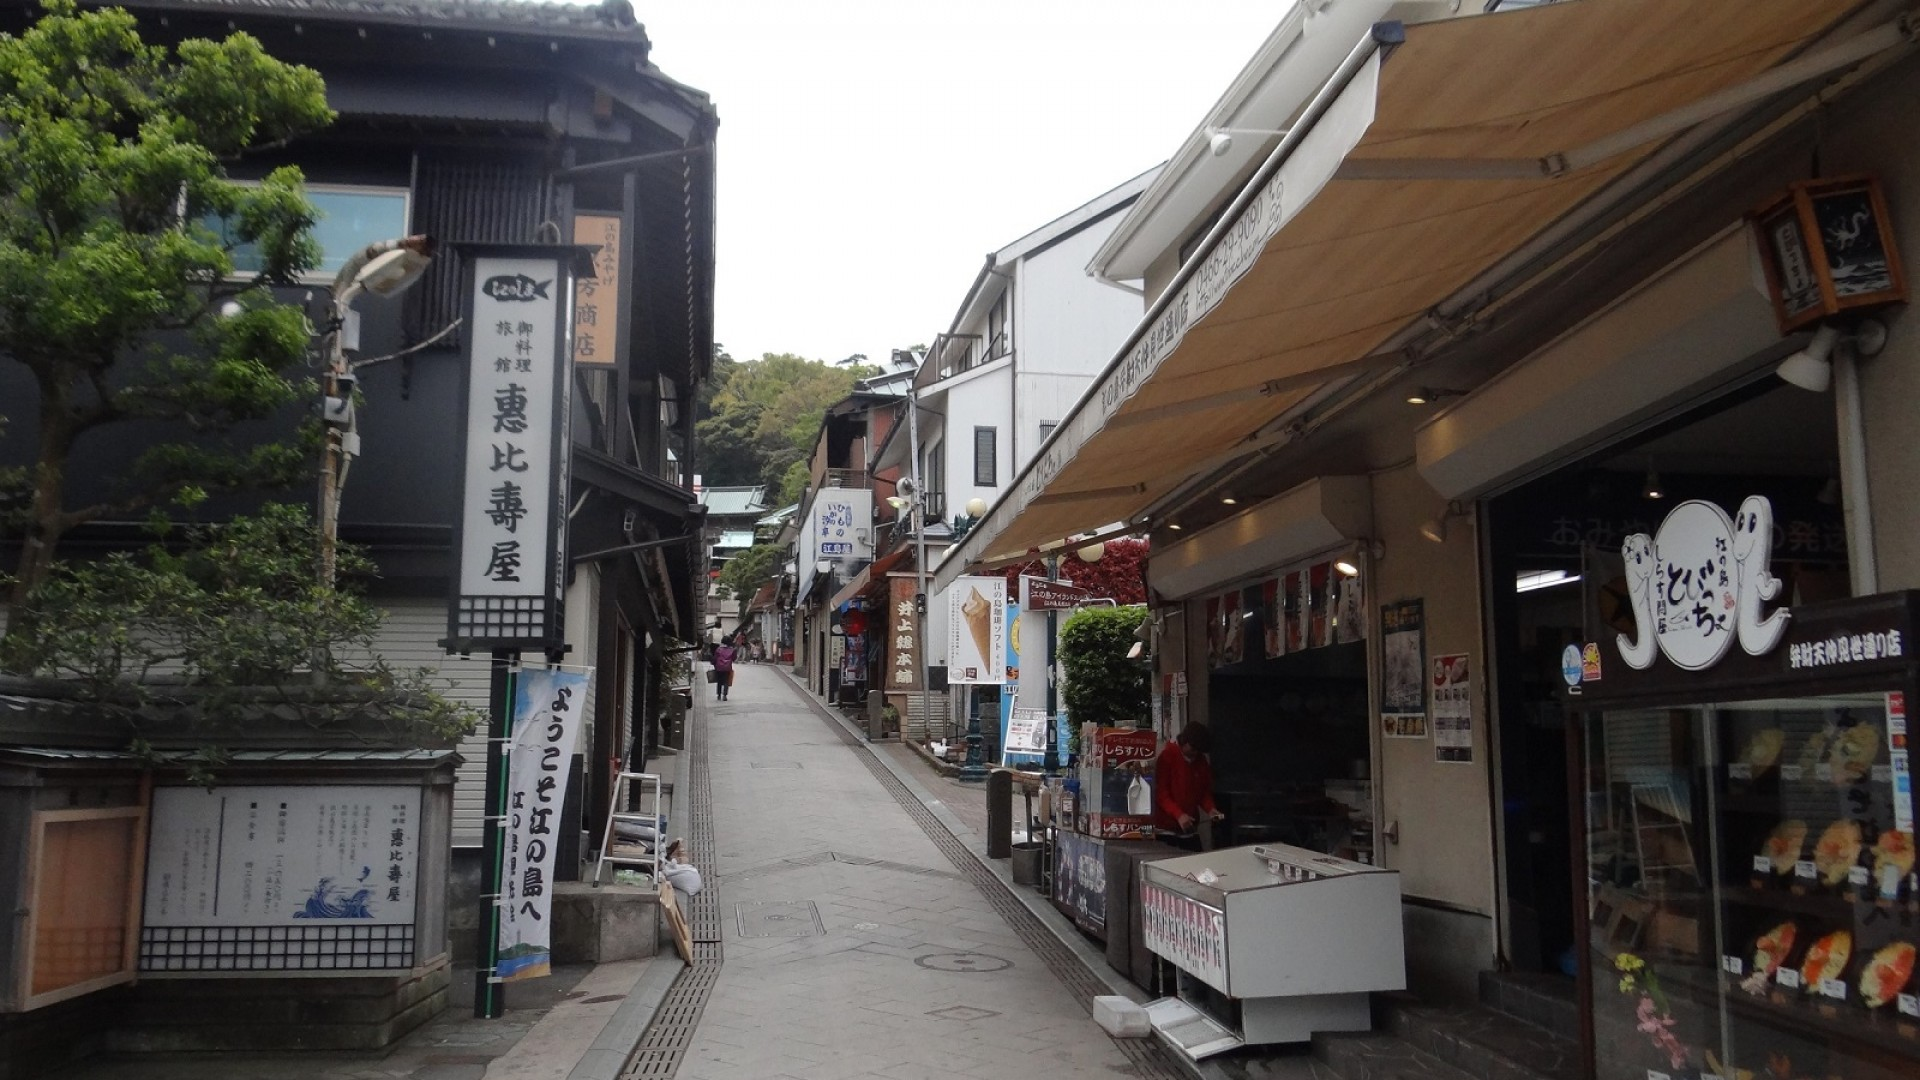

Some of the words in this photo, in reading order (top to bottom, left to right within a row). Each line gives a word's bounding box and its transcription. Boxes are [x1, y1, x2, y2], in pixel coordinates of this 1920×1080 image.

[575, 253, 599, 357] 方商店
[1715, 537, 1729, 588] 江の島
[1105, 744, 1155, 757] しらすパン
[521, 687, 572, 921] ようこそ江の島へ
